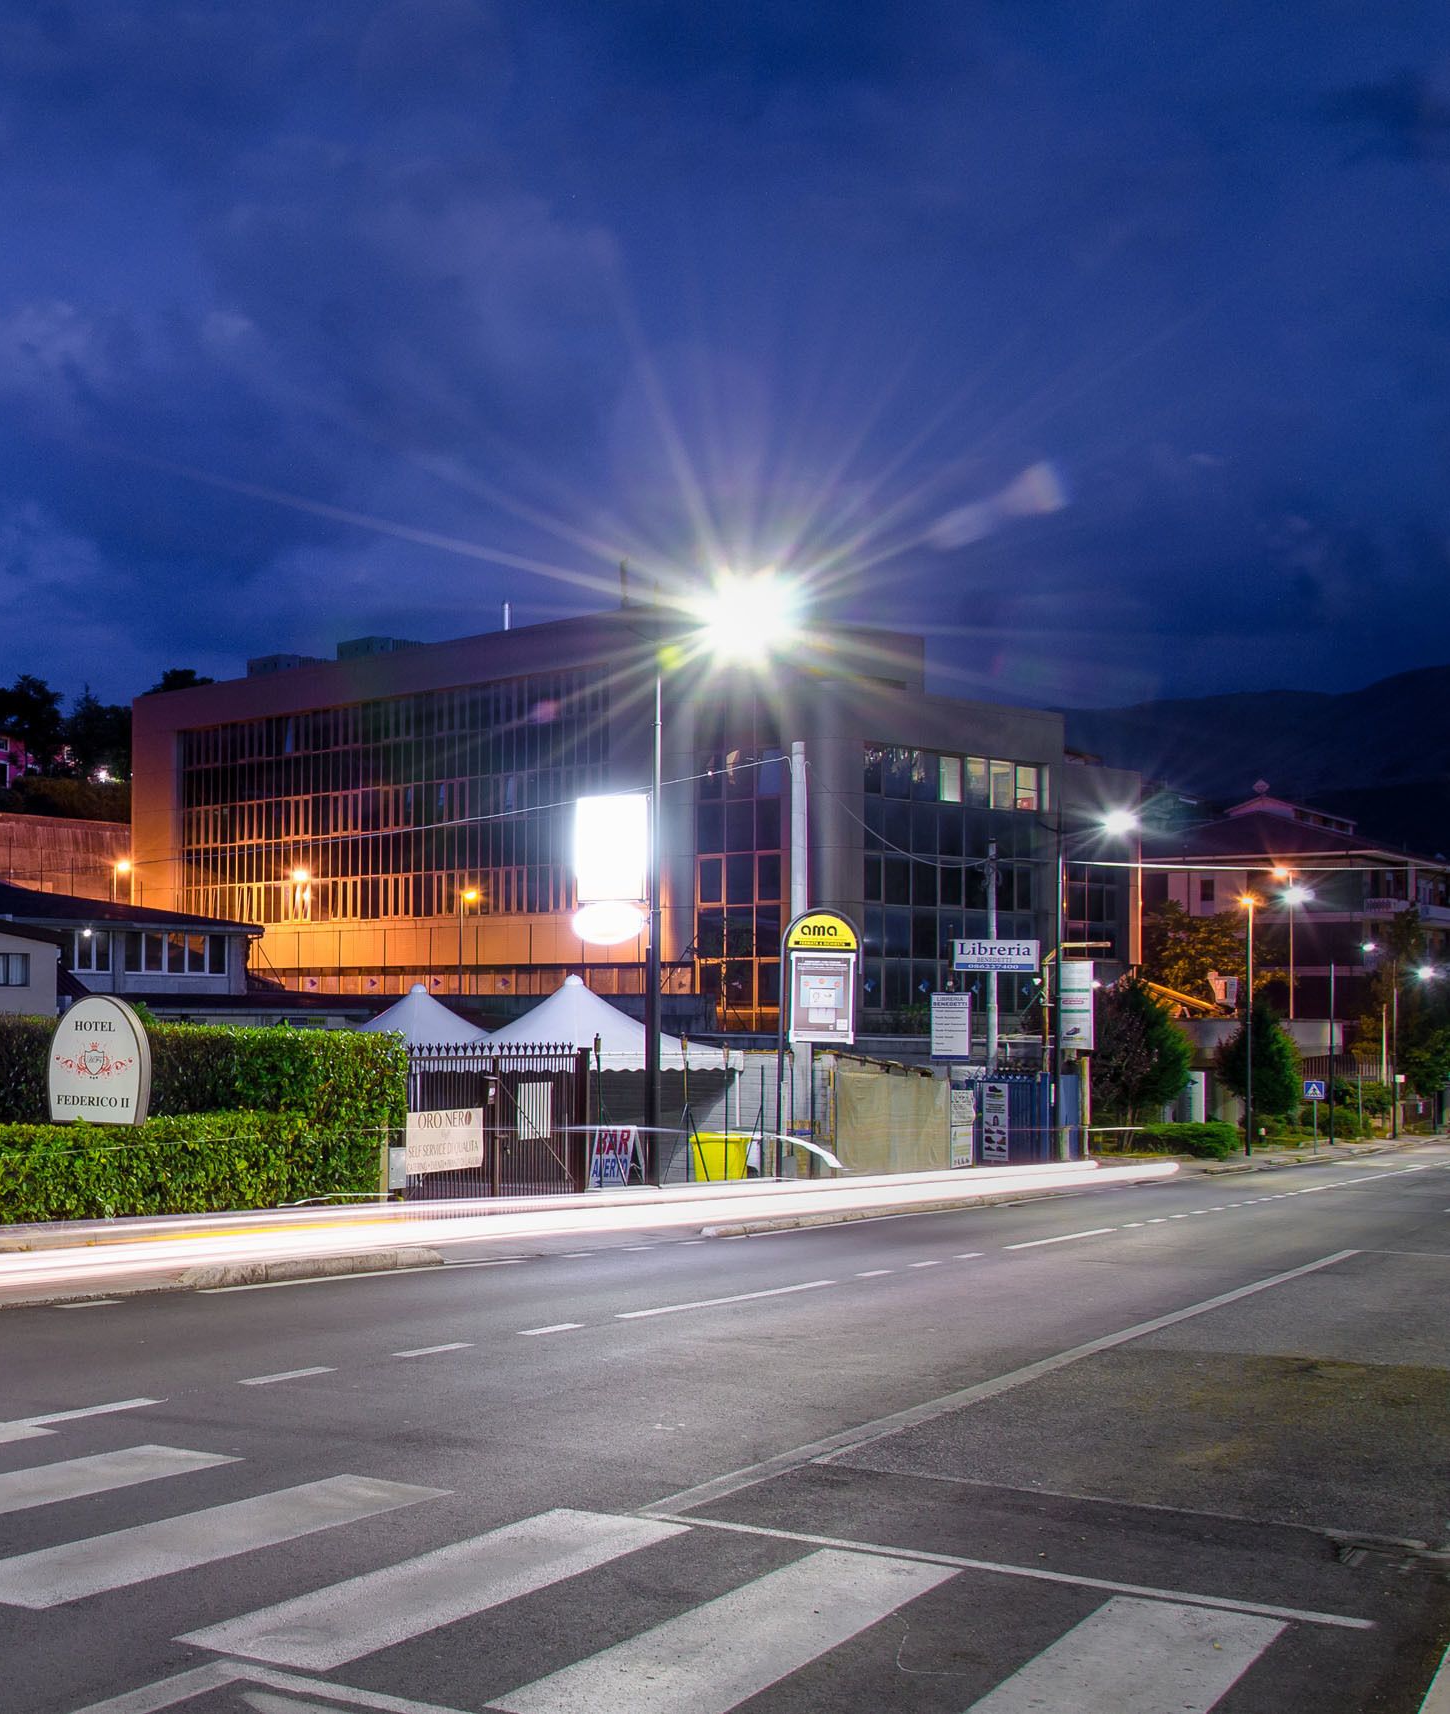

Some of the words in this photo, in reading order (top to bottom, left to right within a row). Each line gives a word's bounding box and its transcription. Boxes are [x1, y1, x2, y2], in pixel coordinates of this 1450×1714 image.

[801, 925, 837, 936] ama
[958, 943, 1031, 956] Libreria
[74, 1021, 115, 1032] HOTEL
[57, 1095, 117, 1108] FEDERICO
[120, 1097, 129, 1108] II
[418, 1111, 442, 1129] ORO
[446, 1110, 472, 1127] NERO
[595, 1128, 630, 1155] BAR
[423, 1143, 446, 1157] SERVICE
